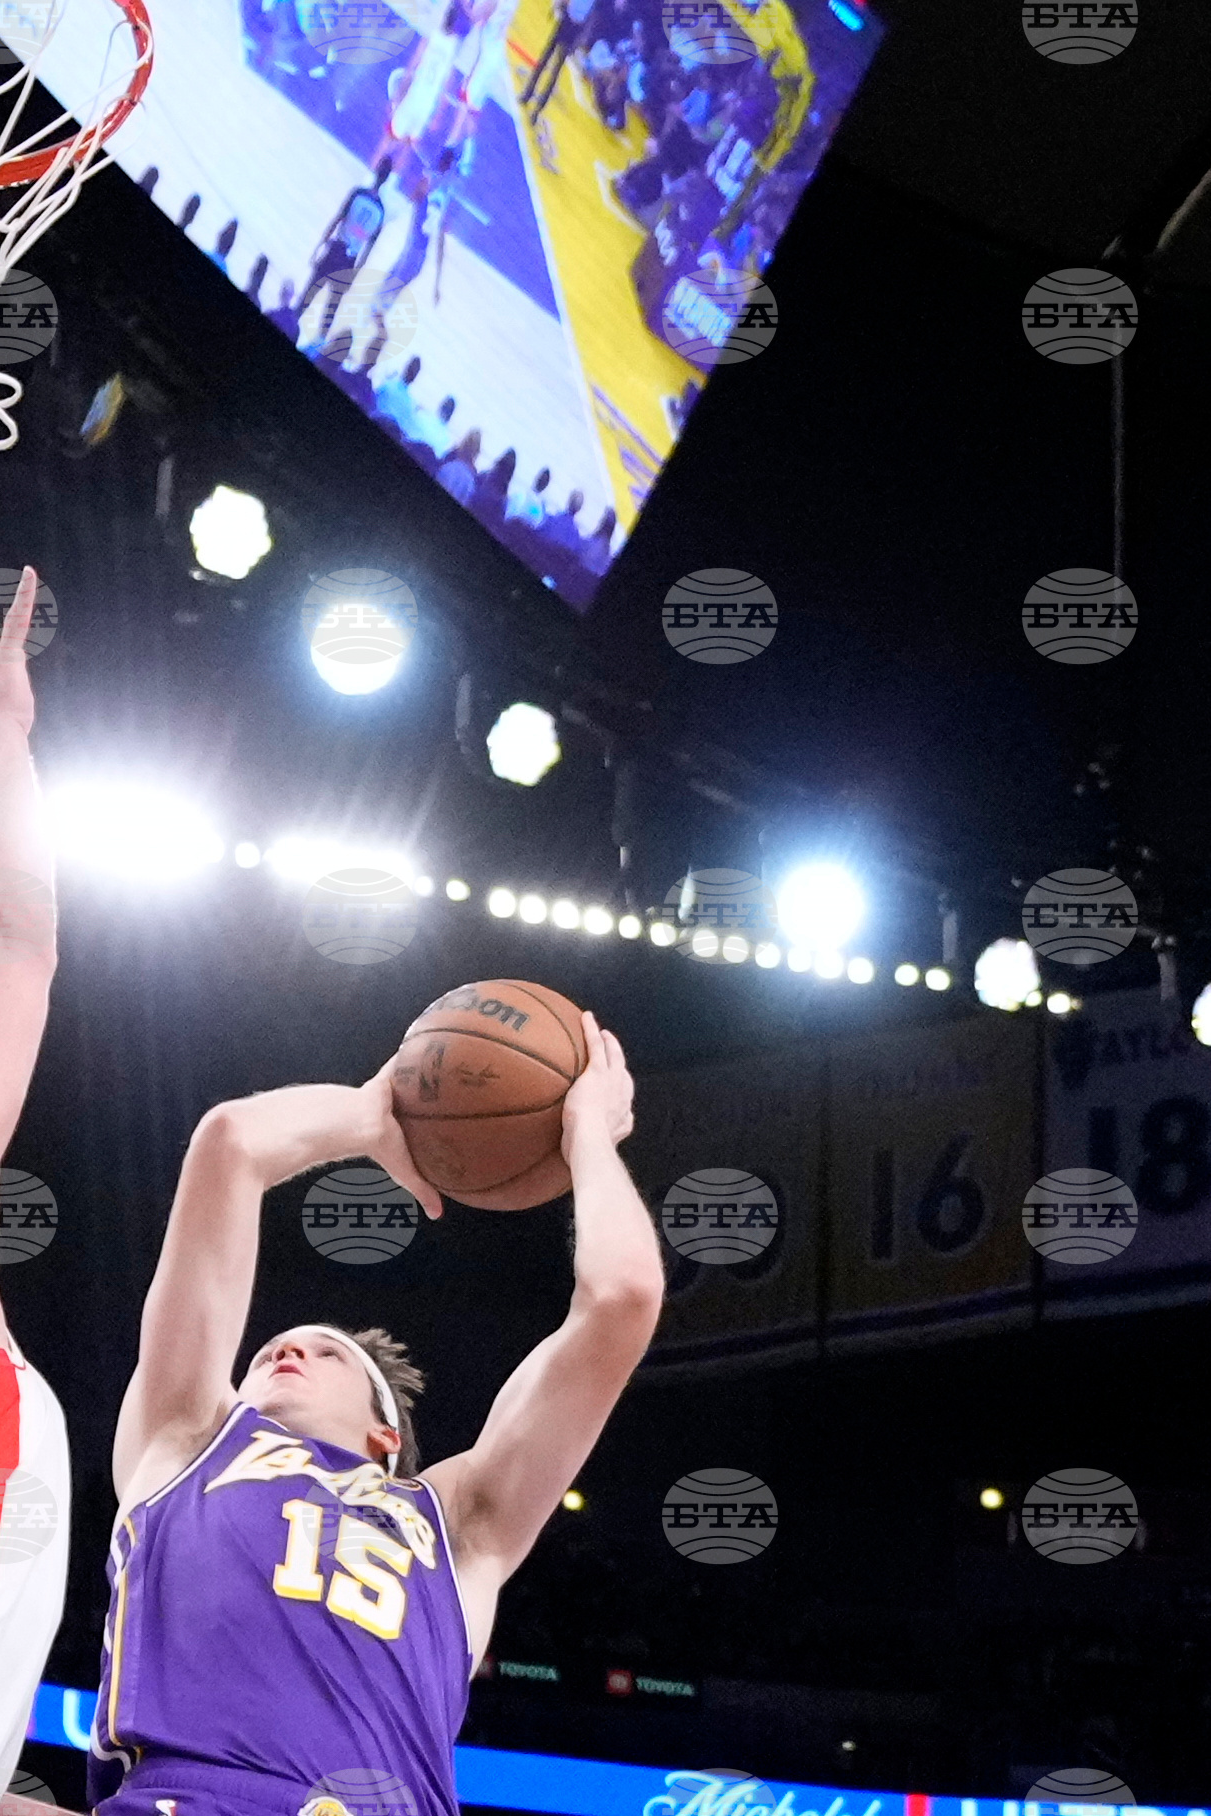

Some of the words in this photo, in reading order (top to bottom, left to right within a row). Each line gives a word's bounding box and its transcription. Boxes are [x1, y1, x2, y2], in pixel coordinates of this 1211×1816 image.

[871, 1130, 985, 1258] 16
[273, 1499, 413, 1640] 15
[499, 1660, 559, 1682] TOYOTA
